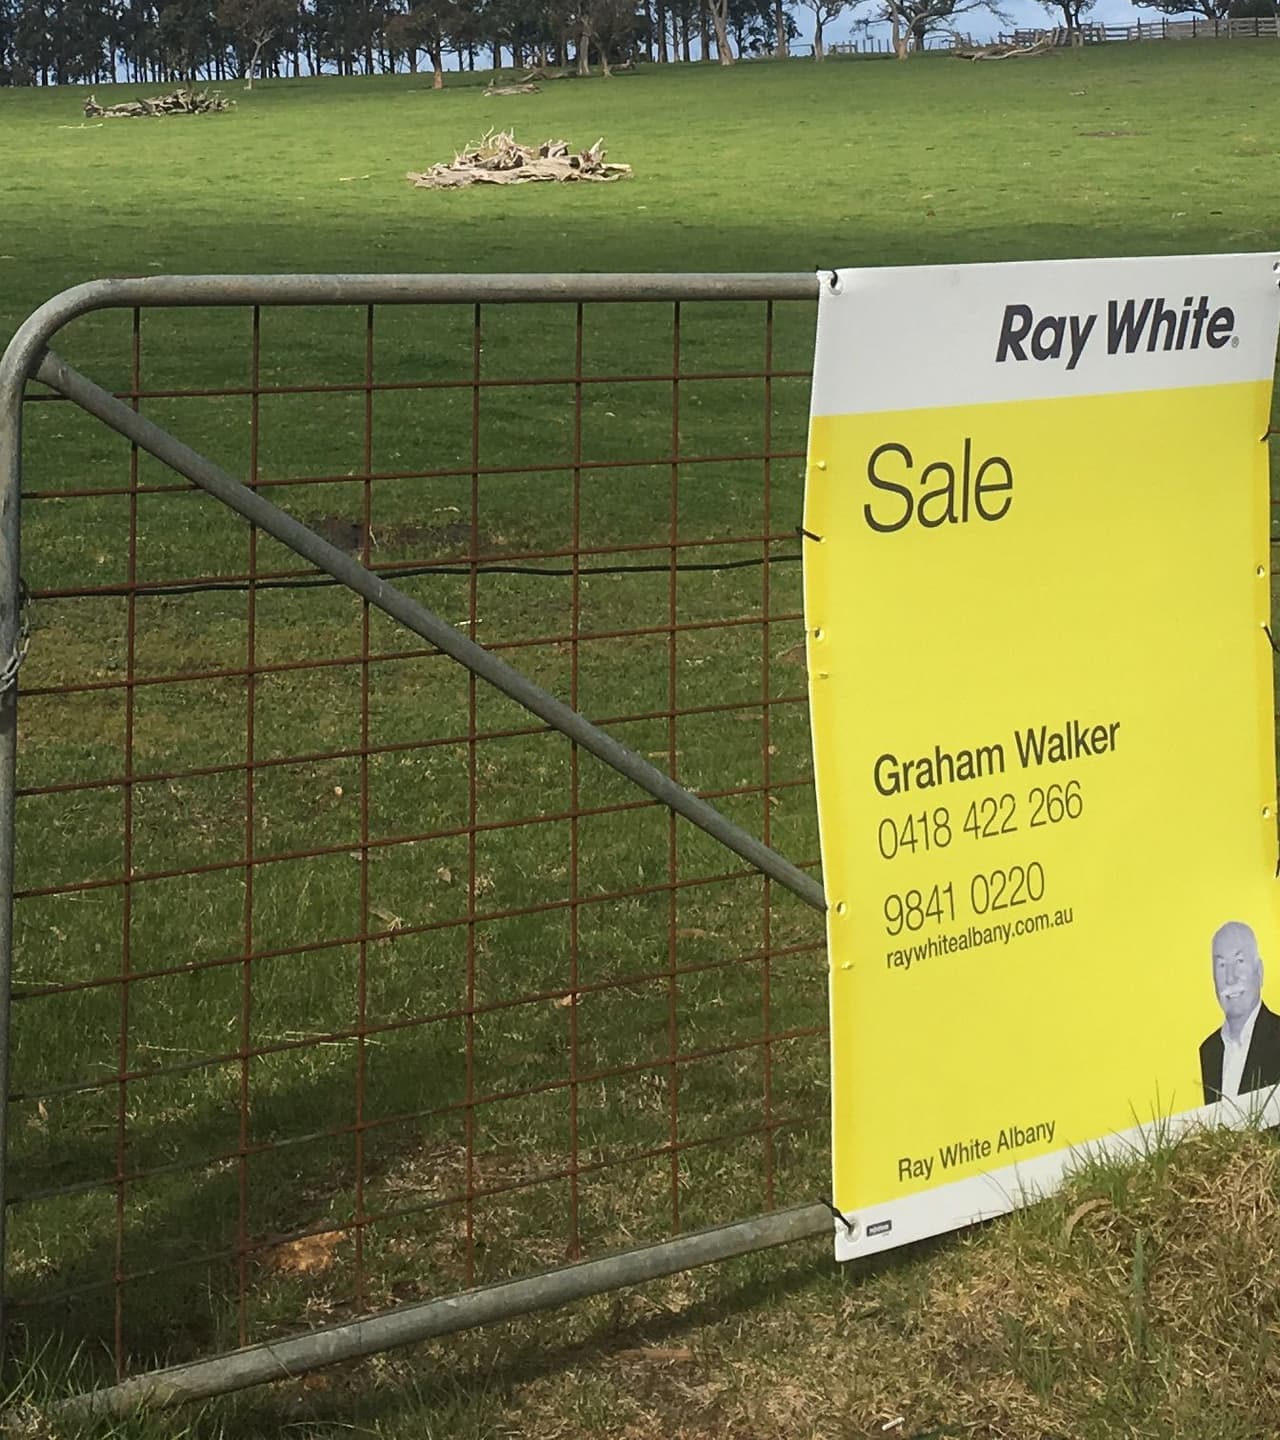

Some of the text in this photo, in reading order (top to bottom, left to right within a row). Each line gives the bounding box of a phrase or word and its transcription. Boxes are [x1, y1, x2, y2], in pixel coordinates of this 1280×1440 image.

[995, 295, 1235, 371] Ray White
[863, 437, 1013, 533] Sale
[873, 719, 1121, 796] Graham Walker
[878, 779, 1083, 860] 0418 422 266
[884, 861, 1046, 936] 9841 0220
[886, 906, 1074, 969] raywhitealbany.com.au
[898, 1120, 1056, 1182] Ray White Albany
